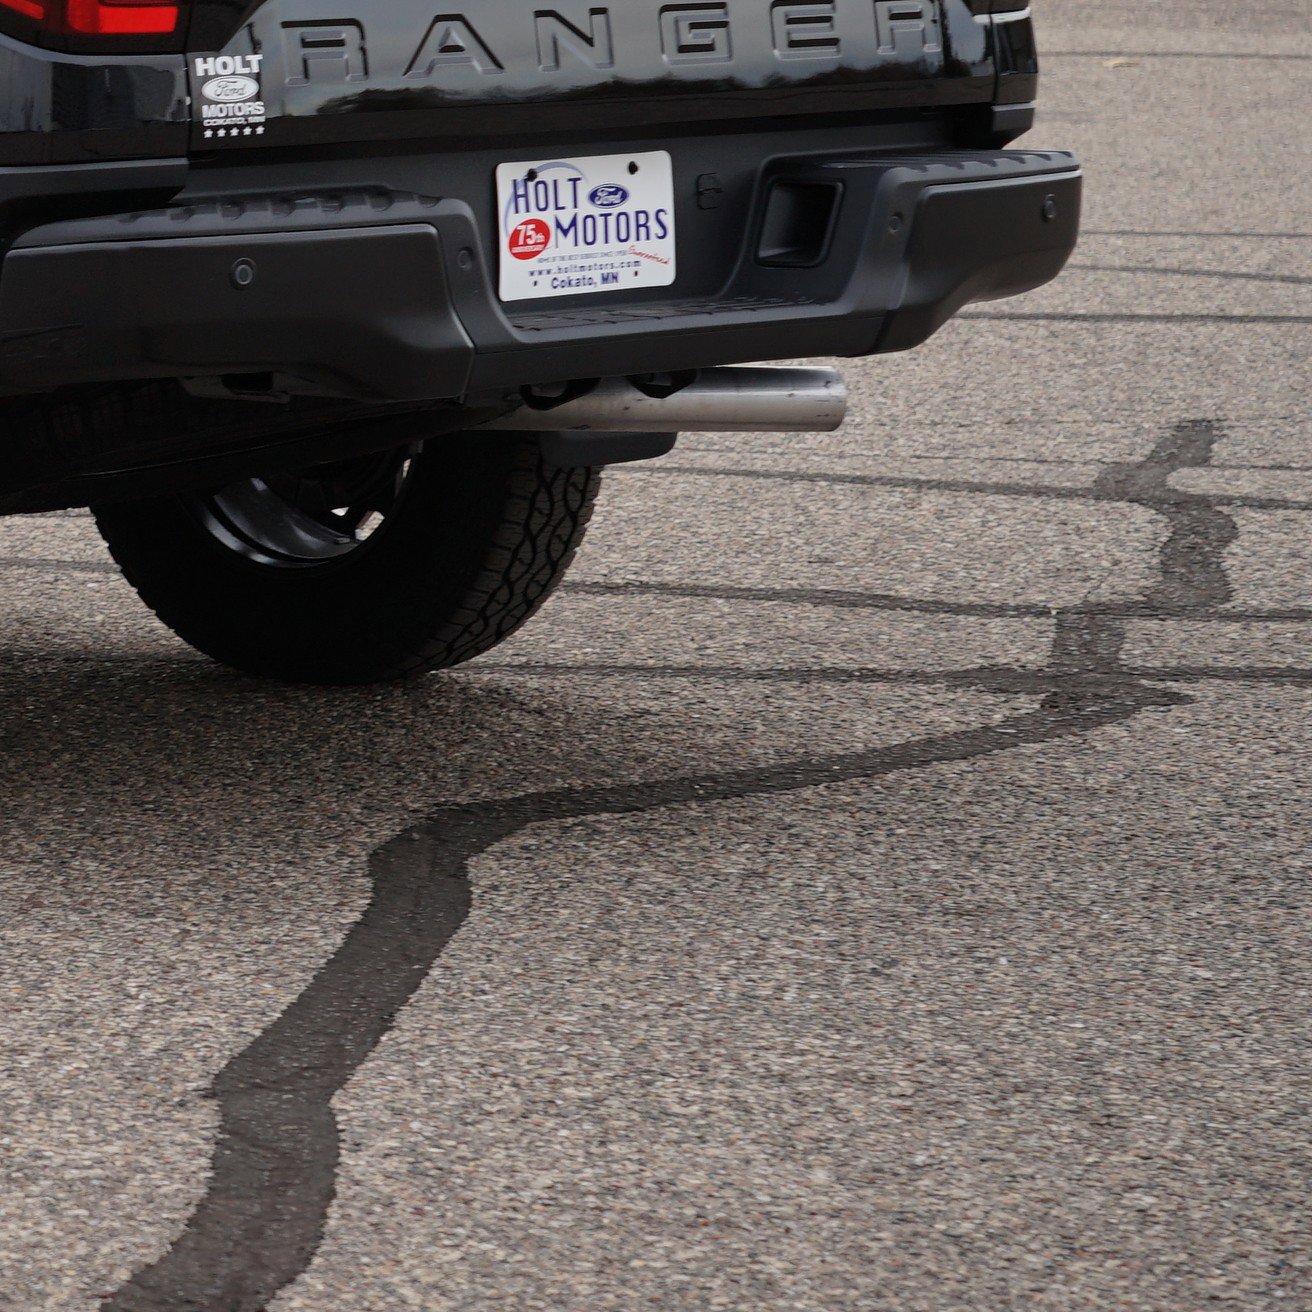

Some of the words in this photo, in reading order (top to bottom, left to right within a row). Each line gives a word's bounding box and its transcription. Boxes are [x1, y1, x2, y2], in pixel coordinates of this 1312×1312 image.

[194, 53, 264, 77] HOLT
[214, 79, 248, 97] Ford
[201, 100, 265, 118] MOTORS
[512, 177, 582, 215] HOLT
[594, 187, 624, 206] Ford
[554, 208, 669, 249] MOTORS
[551, 276, 598, 290] Cokato,
[601, 271, 619, 285] MN
